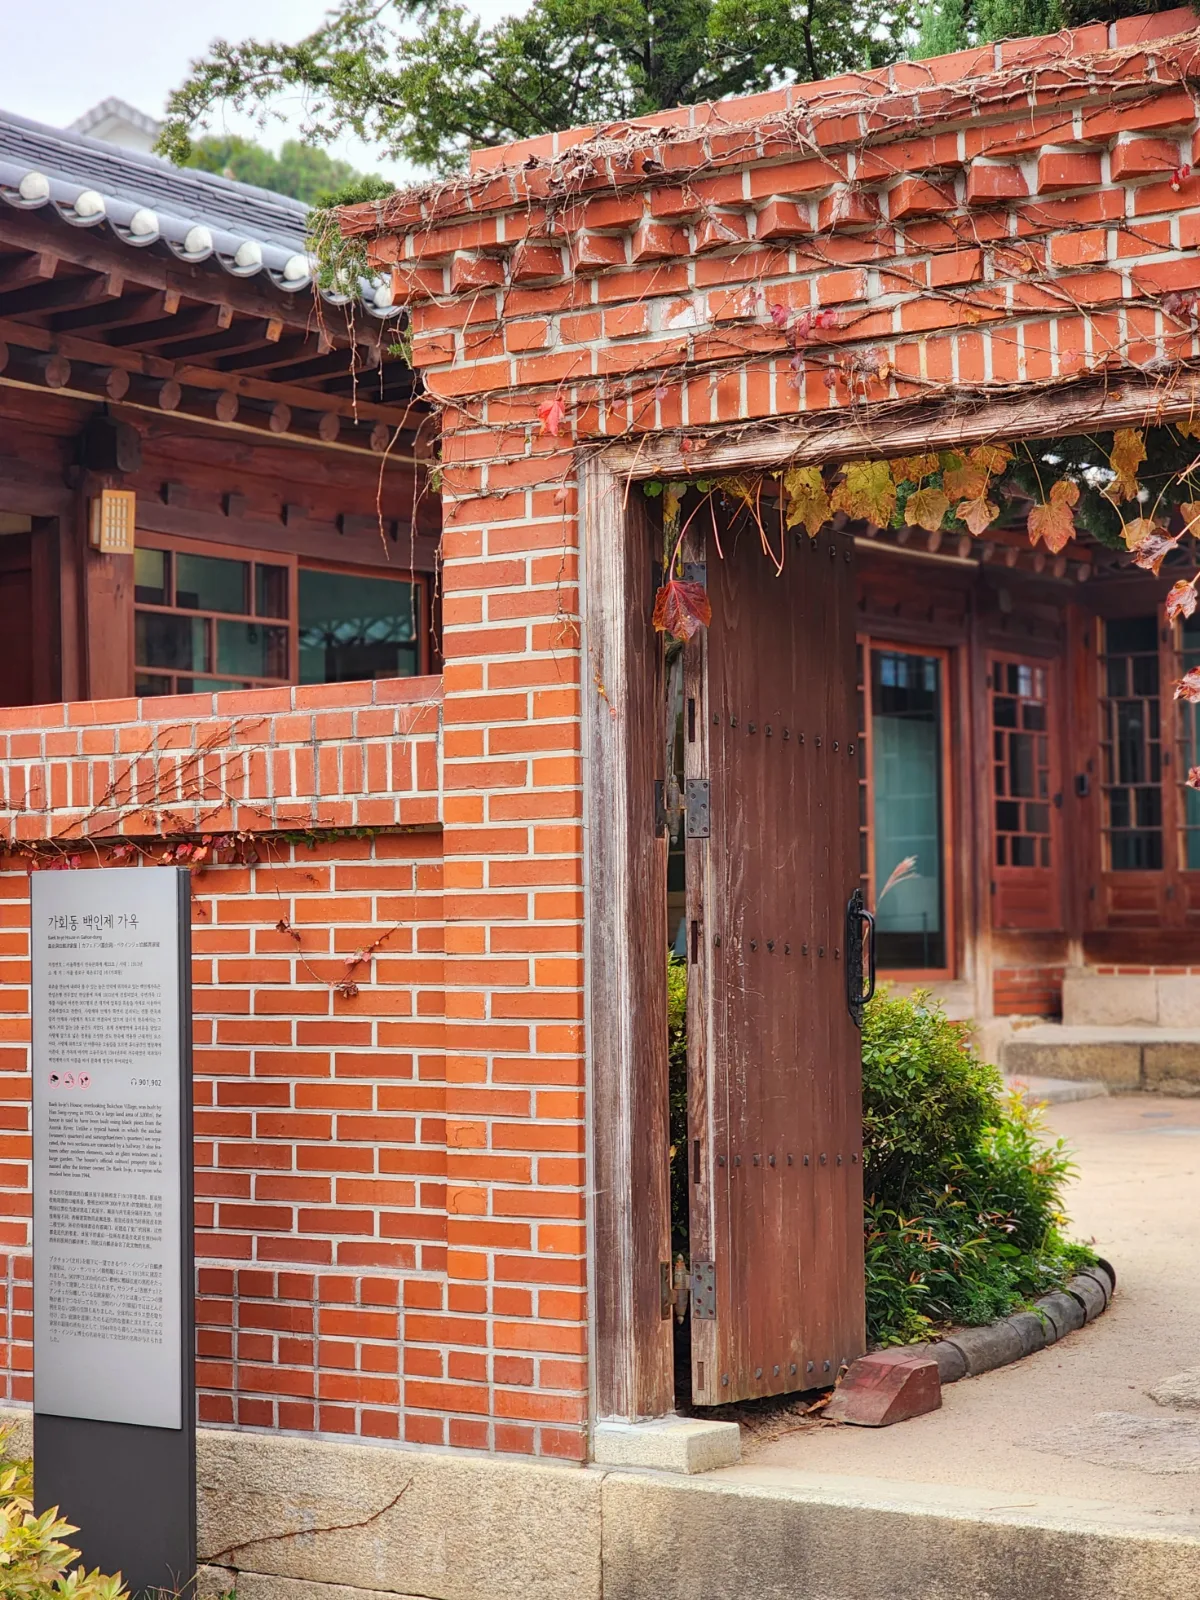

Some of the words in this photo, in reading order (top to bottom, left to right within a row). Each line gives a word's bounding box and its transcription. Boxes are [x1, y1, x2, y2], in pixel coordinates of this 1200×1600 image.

[48, 914, 79, 931] 가회동
[82, 914, 114, 931] 백인제
[117, 913, 140, 930] 가옥
[139, 1078, 162, 1087] 901,902
